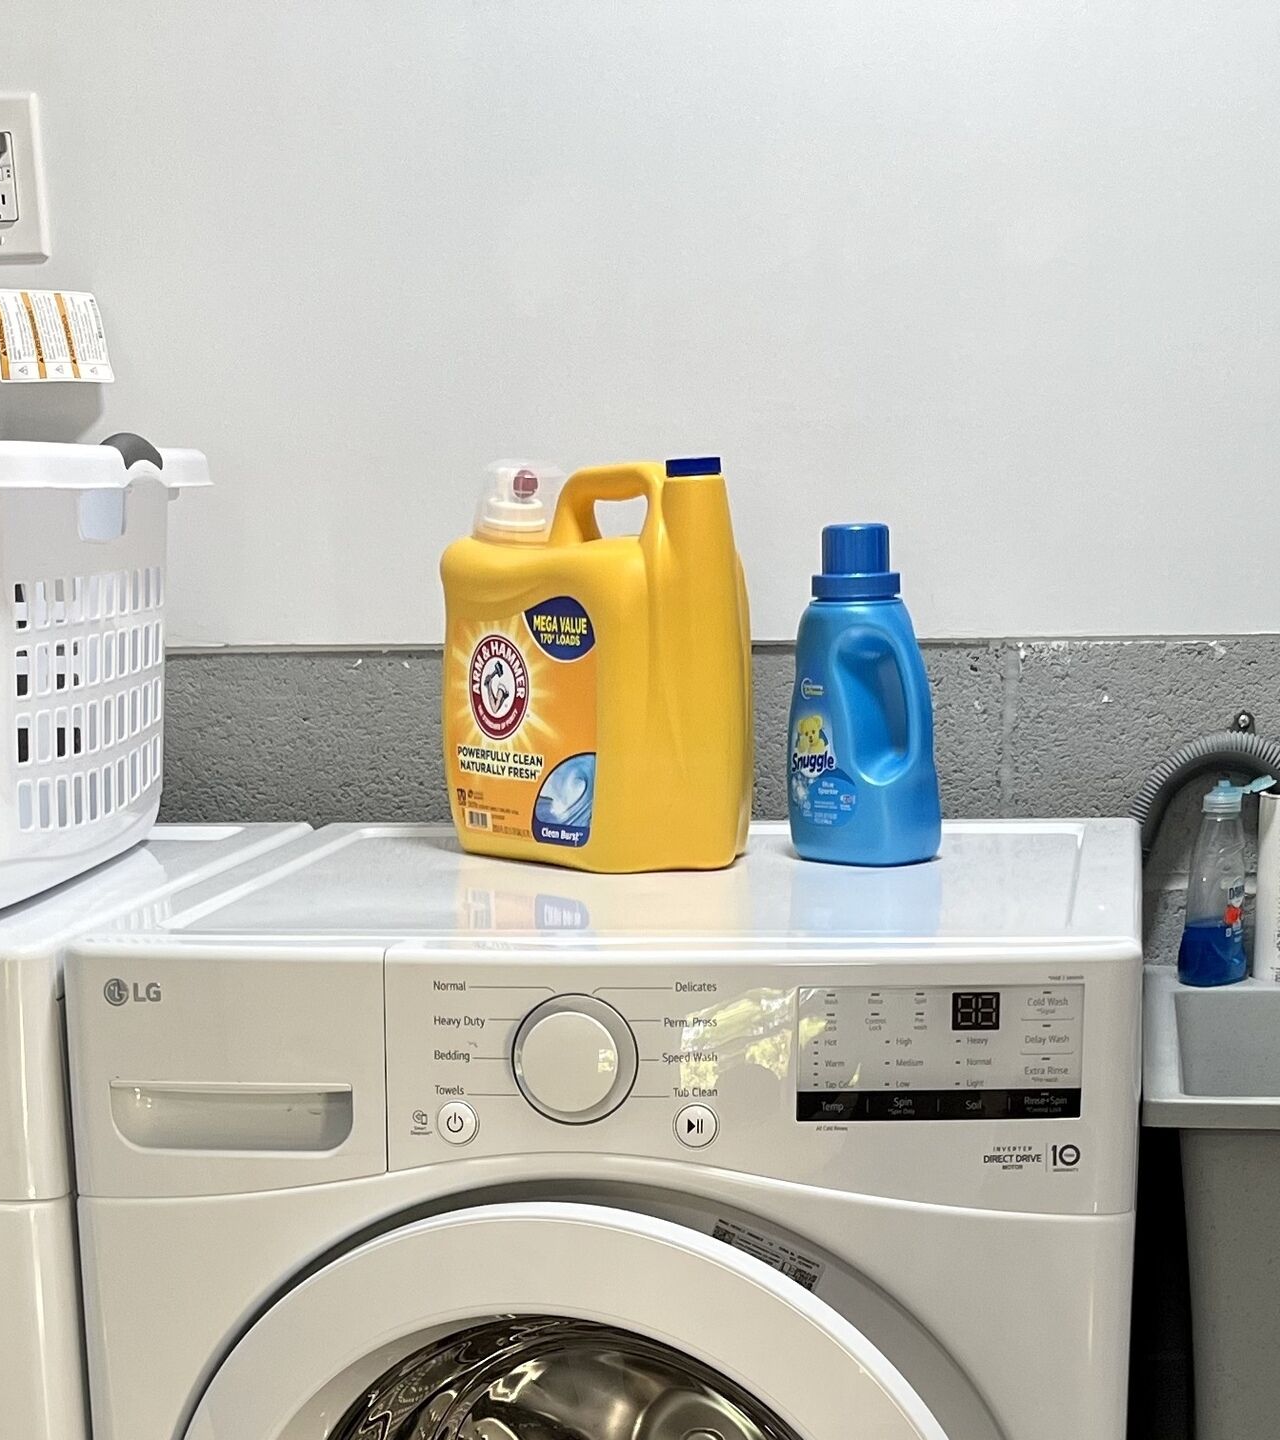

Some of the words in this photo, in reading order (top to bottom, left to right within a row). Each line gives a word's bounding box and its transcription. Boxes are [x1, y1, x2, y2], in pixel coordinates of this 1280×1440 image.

[533, 615, 558, 632] MEGA
[560, 616, 588, 635] VALUE
[556, 634, 581, 647] LOADS
[473, 654, 485, 695] ARM
[481, 645, 491, 659] &
[490, 641, 526, 699] HAMMER
[458, 746, 511, 763] POWERFULLY
[512, 754, 543, 767] CLEAN
[460, 760, 507, 777] NATURALLY
[792, 753, 835, 773] Snuggle
[541, 827, 560, 839] Clean
[433, 980, 466, 992] Normal
[675, 982, 718, 993] Delicates
[133, 982, 162, 1002] LG
[1027, 998, 1045, 1007] Cold
[1047, 997, 1069, 1006] Wash
[433, 1015, 461, 1028] Heavy
[463, 1015, 485, 1028] Duty
[664, 1017, 689, 1028] Perm.
[692, 1017, 718, 1028] Press
[896, 1038, 913, 1047] High
[966, 1037, 988, 1046] Heavy
[1025, 1035, 1046, 1045] Delay
[1048, 1035, 1070, 1044] Wash
[434, 1050, 470, 1063] Bedding
[662, 1052, 690, 1065] Speed
[693, 1052, 718, 1062] Wash
[966, 1058, 992, 1066] Normal
[824, 1060, 845, 1068] Warm
[895, 1059, 924, 1067] Medium
[1024, 1066, 1046, 1075] Extra
[1047, 1066, 1069, 1075] Rinse
[825, 1081, 838, 1090] Tap
[966, 1079, 985, 1089] Light
[435, 1084, 465, 1096] Towels
[673, 1088, 690, 1098] Tub
[692, 1087, 718, 1097] Clean
[894, 1097, 913, 1109] Spin
[965, 1099, 982, 1110] Soil
[983, 1154, 1015, 1164] DIRECT
[1016, 1154, 1042, 1163] DRIVE
[1051, 1144, 1081, 1166] 10
